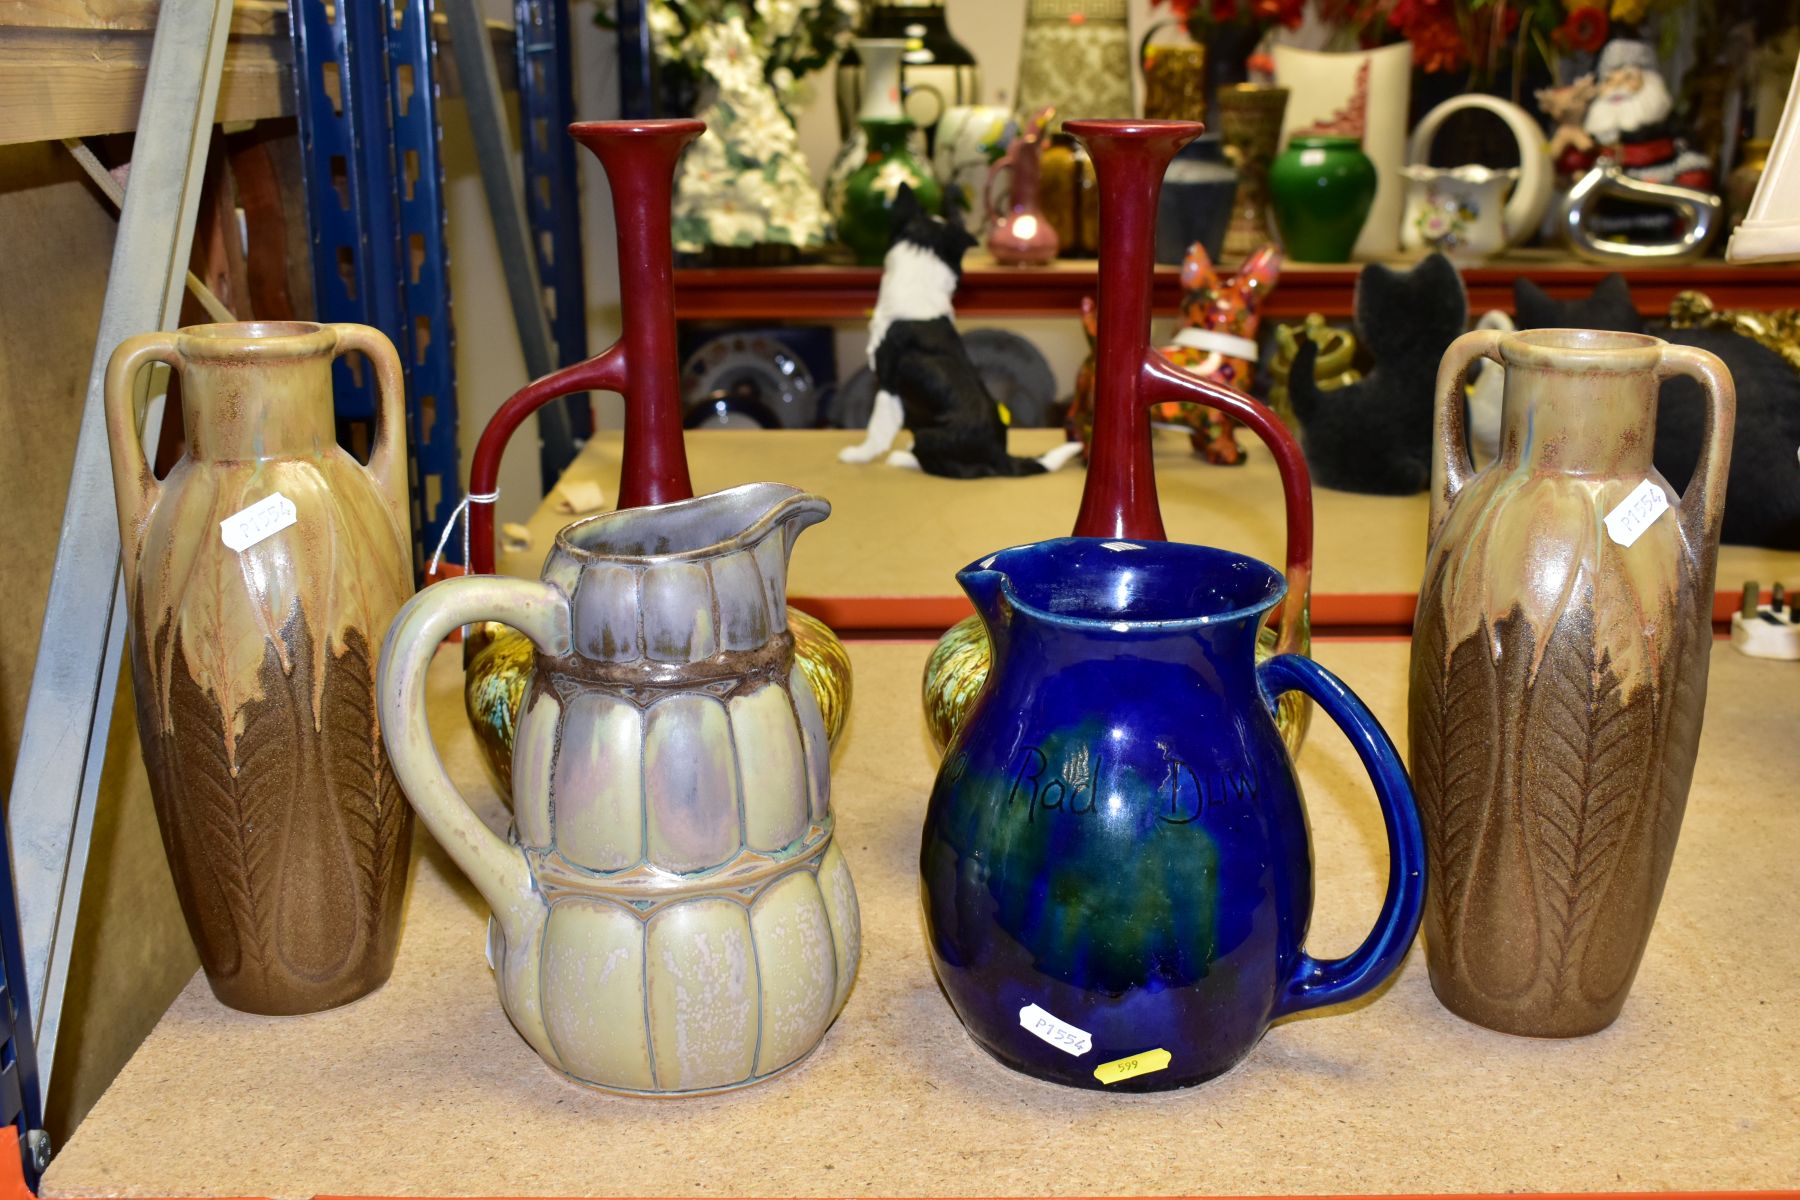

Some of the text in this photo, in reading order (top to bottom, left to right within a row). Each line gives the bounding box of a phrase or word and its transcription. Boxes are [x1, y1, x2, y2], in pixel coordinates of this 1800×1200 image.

[1620, 488, 1662, 532] P1554
[1009, 746, 1101, 823] Rad
[1035, 1018, 1083, 1051] P1554
[1118, 1060, 1138, 1073] 599
